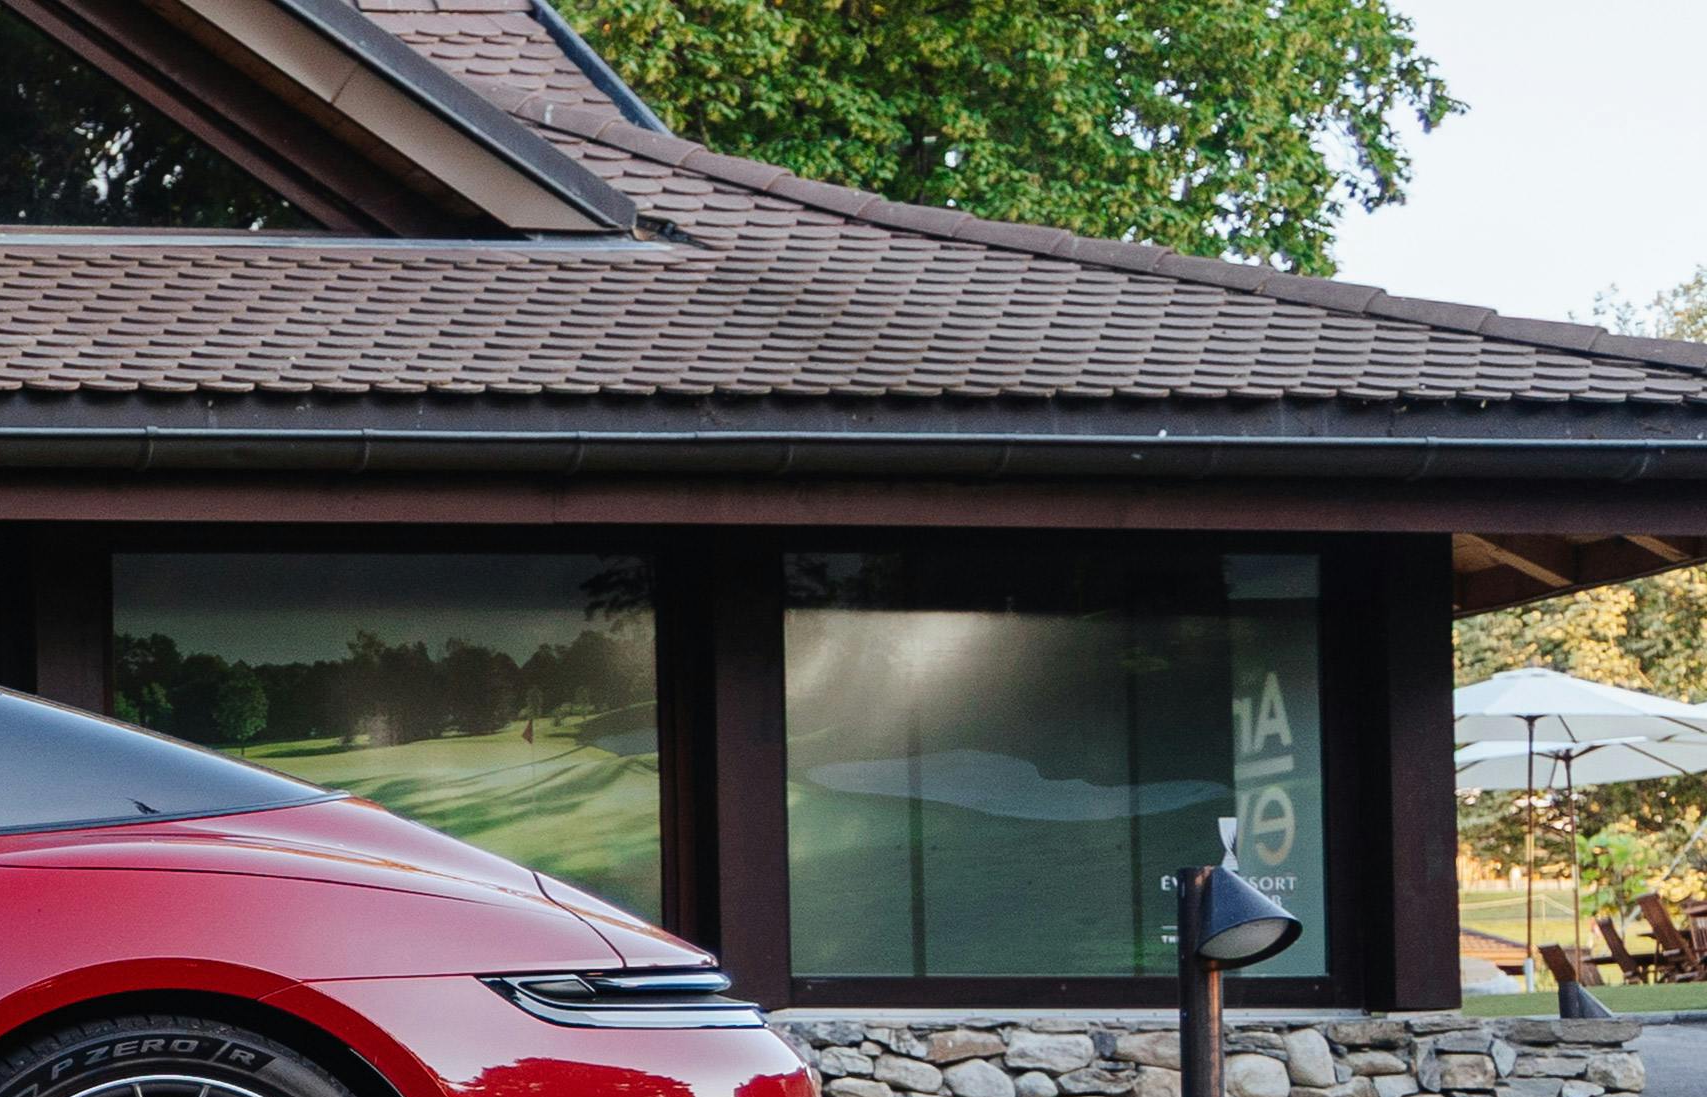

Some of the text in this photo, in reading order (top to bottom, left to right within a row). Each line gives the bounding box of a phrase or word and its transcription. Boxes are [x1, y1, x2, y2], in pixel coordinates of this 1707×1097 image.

[50, 1039, 257, 1081] P ZERO R
